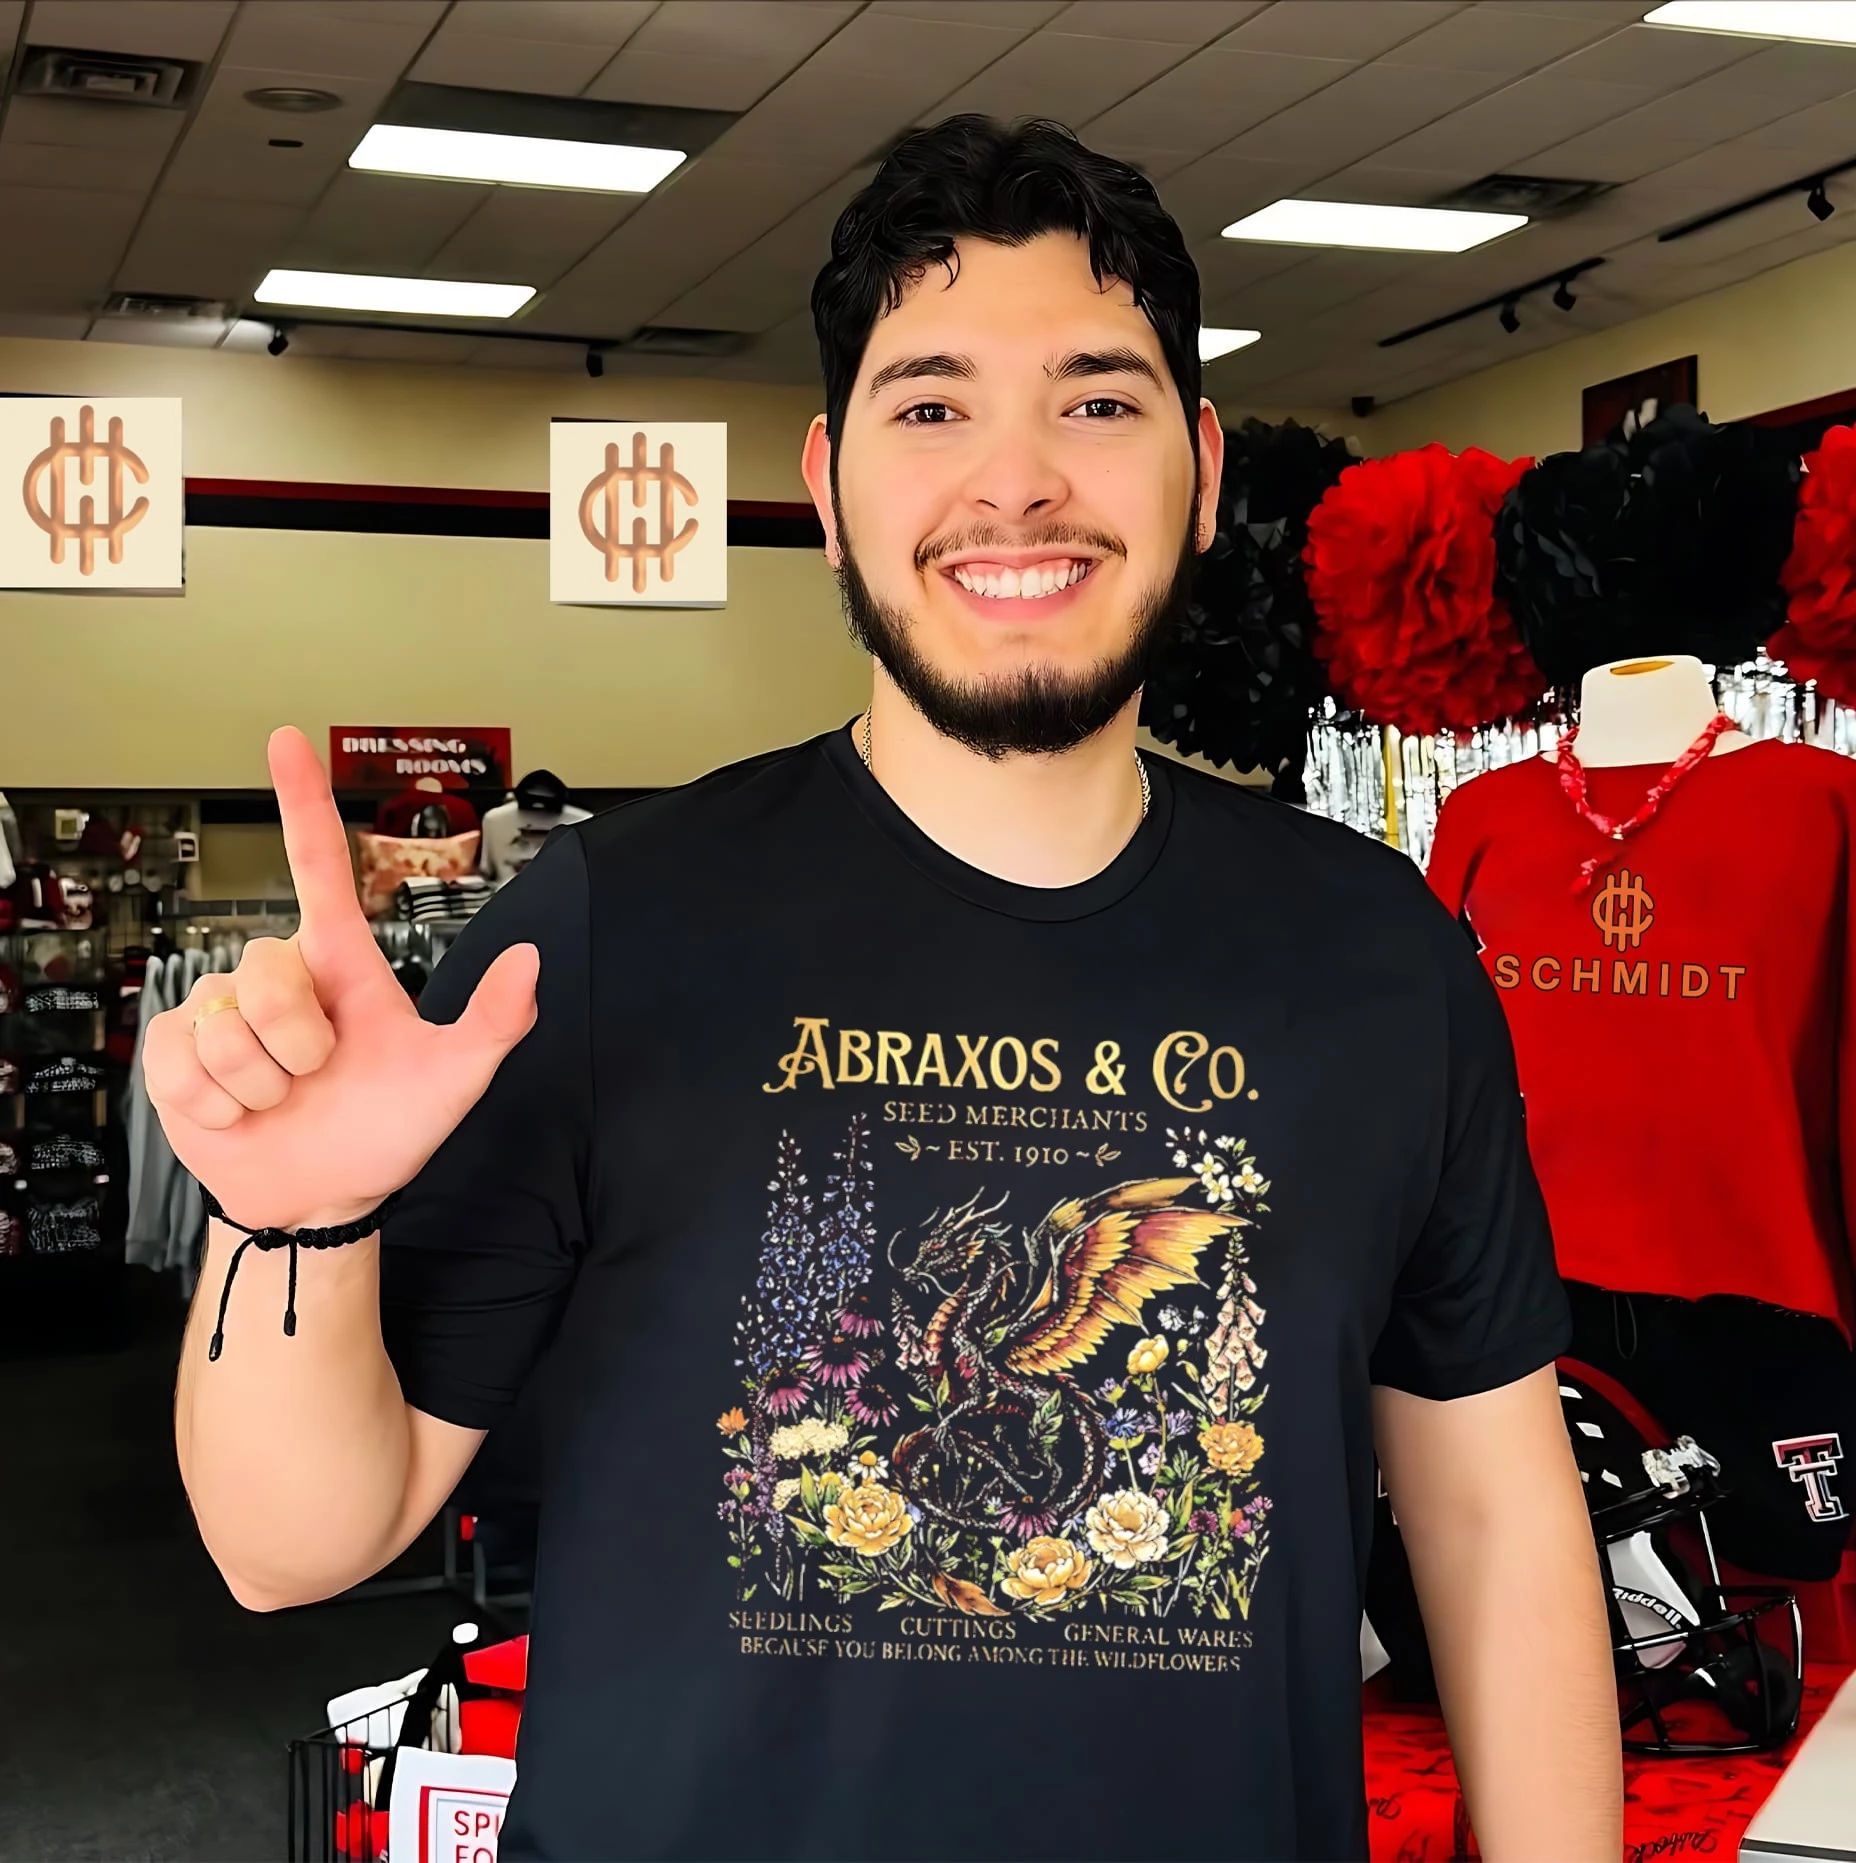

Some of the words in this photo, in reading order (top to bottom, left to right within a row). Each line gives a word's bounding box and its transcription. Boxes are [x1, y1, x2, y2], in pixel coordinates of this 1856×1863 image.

[341, 737, 467, 753] DRESSING
[396, 758, 487, 775] ROOMS
[1494, 954, 1747, 1000] SCHMIDT
[762, 1016, 1062, 1093] ABRAXOS
[1085, 1040, 1127, 1096] &
[883, 1100, 956, 1123] SEED
[965, 1105, 1148, 1132] MERCHANTS
[947, 1139, 1004, 1162] EST.
[1014, 1146, 1069, 1168] 1910
[728, 1611, 853, 1632] SEEDLINGS
[900, 1616, 1017, 1638] CUTTINGS
[1064, 1623, 1170, 1645] GENERAL
[1177, 1628, 1253, 1648] WARES
[740, 1636, 829, 1657] BECAUSE
[835, 1639, 876, 1659] YOU
[882, 1642, 961, 1663] BELONG
[967, 1645, 1043, 1665] AMONG
[1048, 1648, 1089, 1667] THE
[1094, 1650, 1241, 1672] WILDFLOWERS
